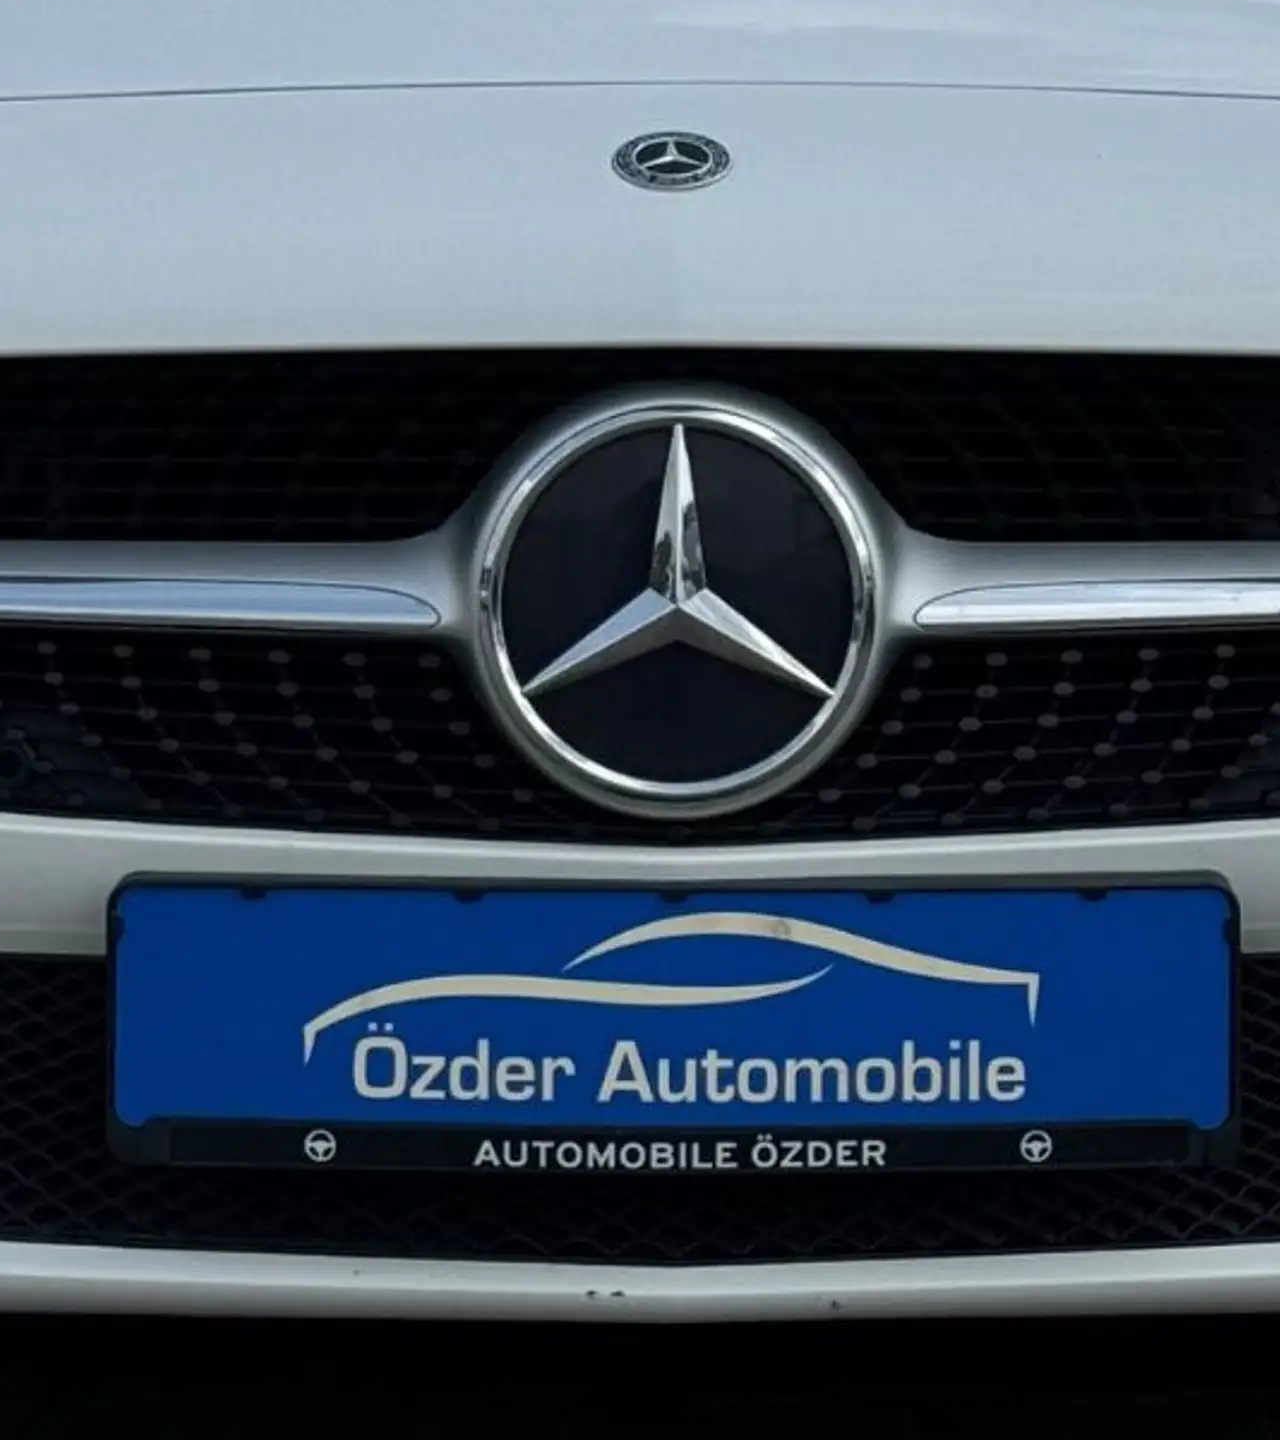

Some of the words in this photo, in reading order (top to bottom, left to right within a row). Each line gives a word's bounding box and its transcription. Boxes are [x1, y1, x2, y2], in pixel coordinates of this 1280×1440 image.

[352, 1021, 577, 1102] Özder
[596, 1039, 1027, 1104] Automobile
[473, 1138, 739, 1169] AUTOMOBILE
[750, 1133, 888, 1168] ÖZDER
